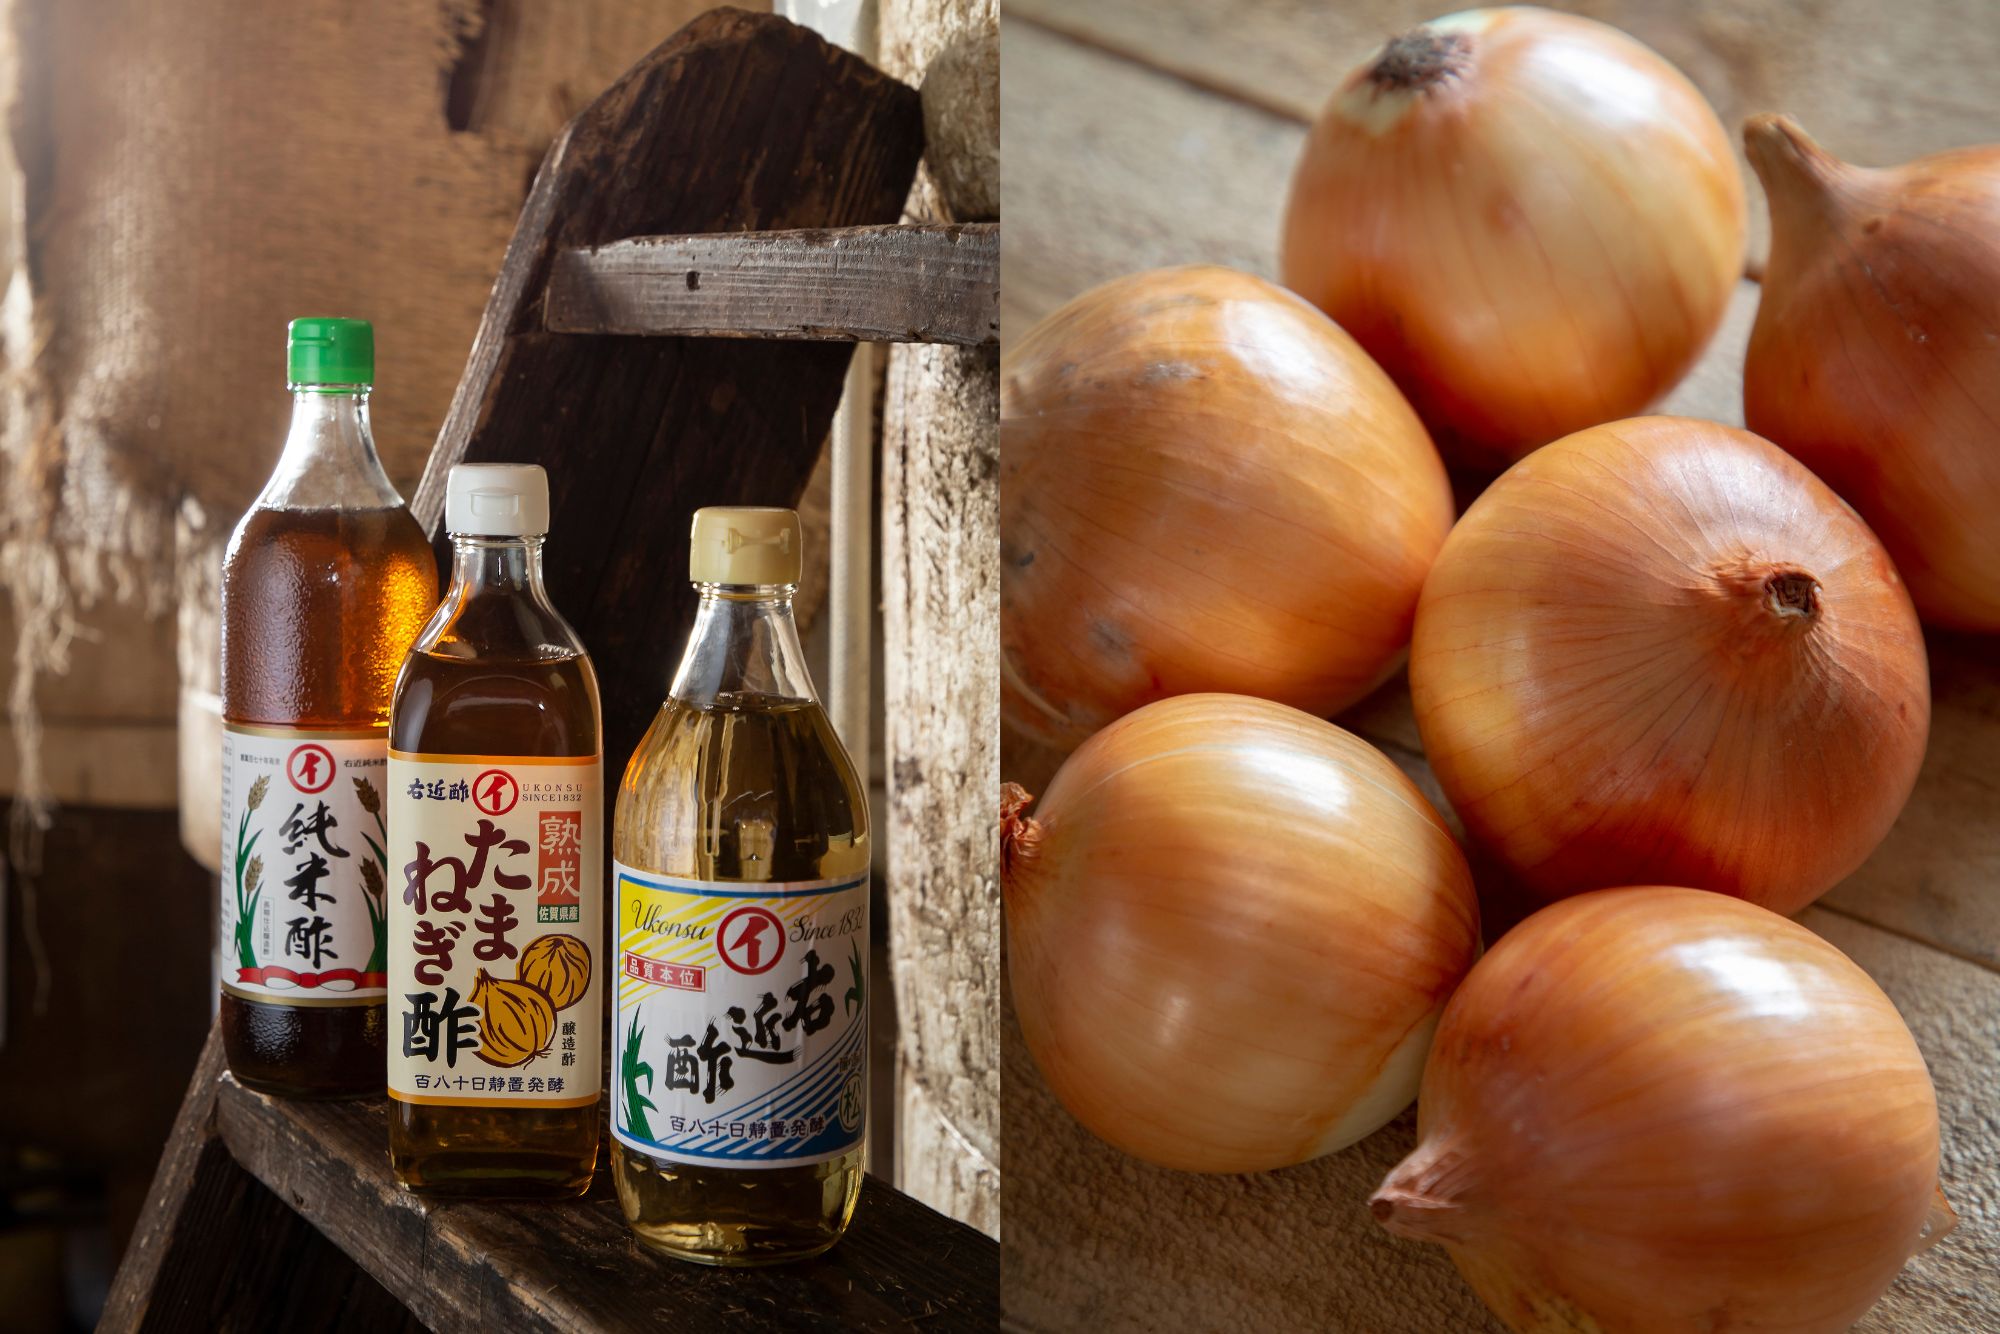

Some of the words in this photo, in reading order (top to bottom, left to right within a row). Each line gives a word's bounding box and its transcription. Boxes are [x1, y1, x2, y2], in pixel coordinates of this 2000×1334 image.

[407, 778, 470, 803] 右近酢
[522, 783, 583, 792] UKONSU
[538, 815, 581, 896] 熟成
[279, 800, 350, 969] 純米酢
[538, 906, 580, 922] 佐賀県産
[631, 899, 710, 940] Ukonsu
[789, 914, 836, 943] Since
[838, 903, 866, 936] 1832
[630, 958, 696, 986] 品質本位
[561, 1020, 577, 1067] 醸造酢
[414, 1074, 566, 1093] 百八十日静置発酵
[670, 1115, 826, 1140] 百八十日静置発酵
